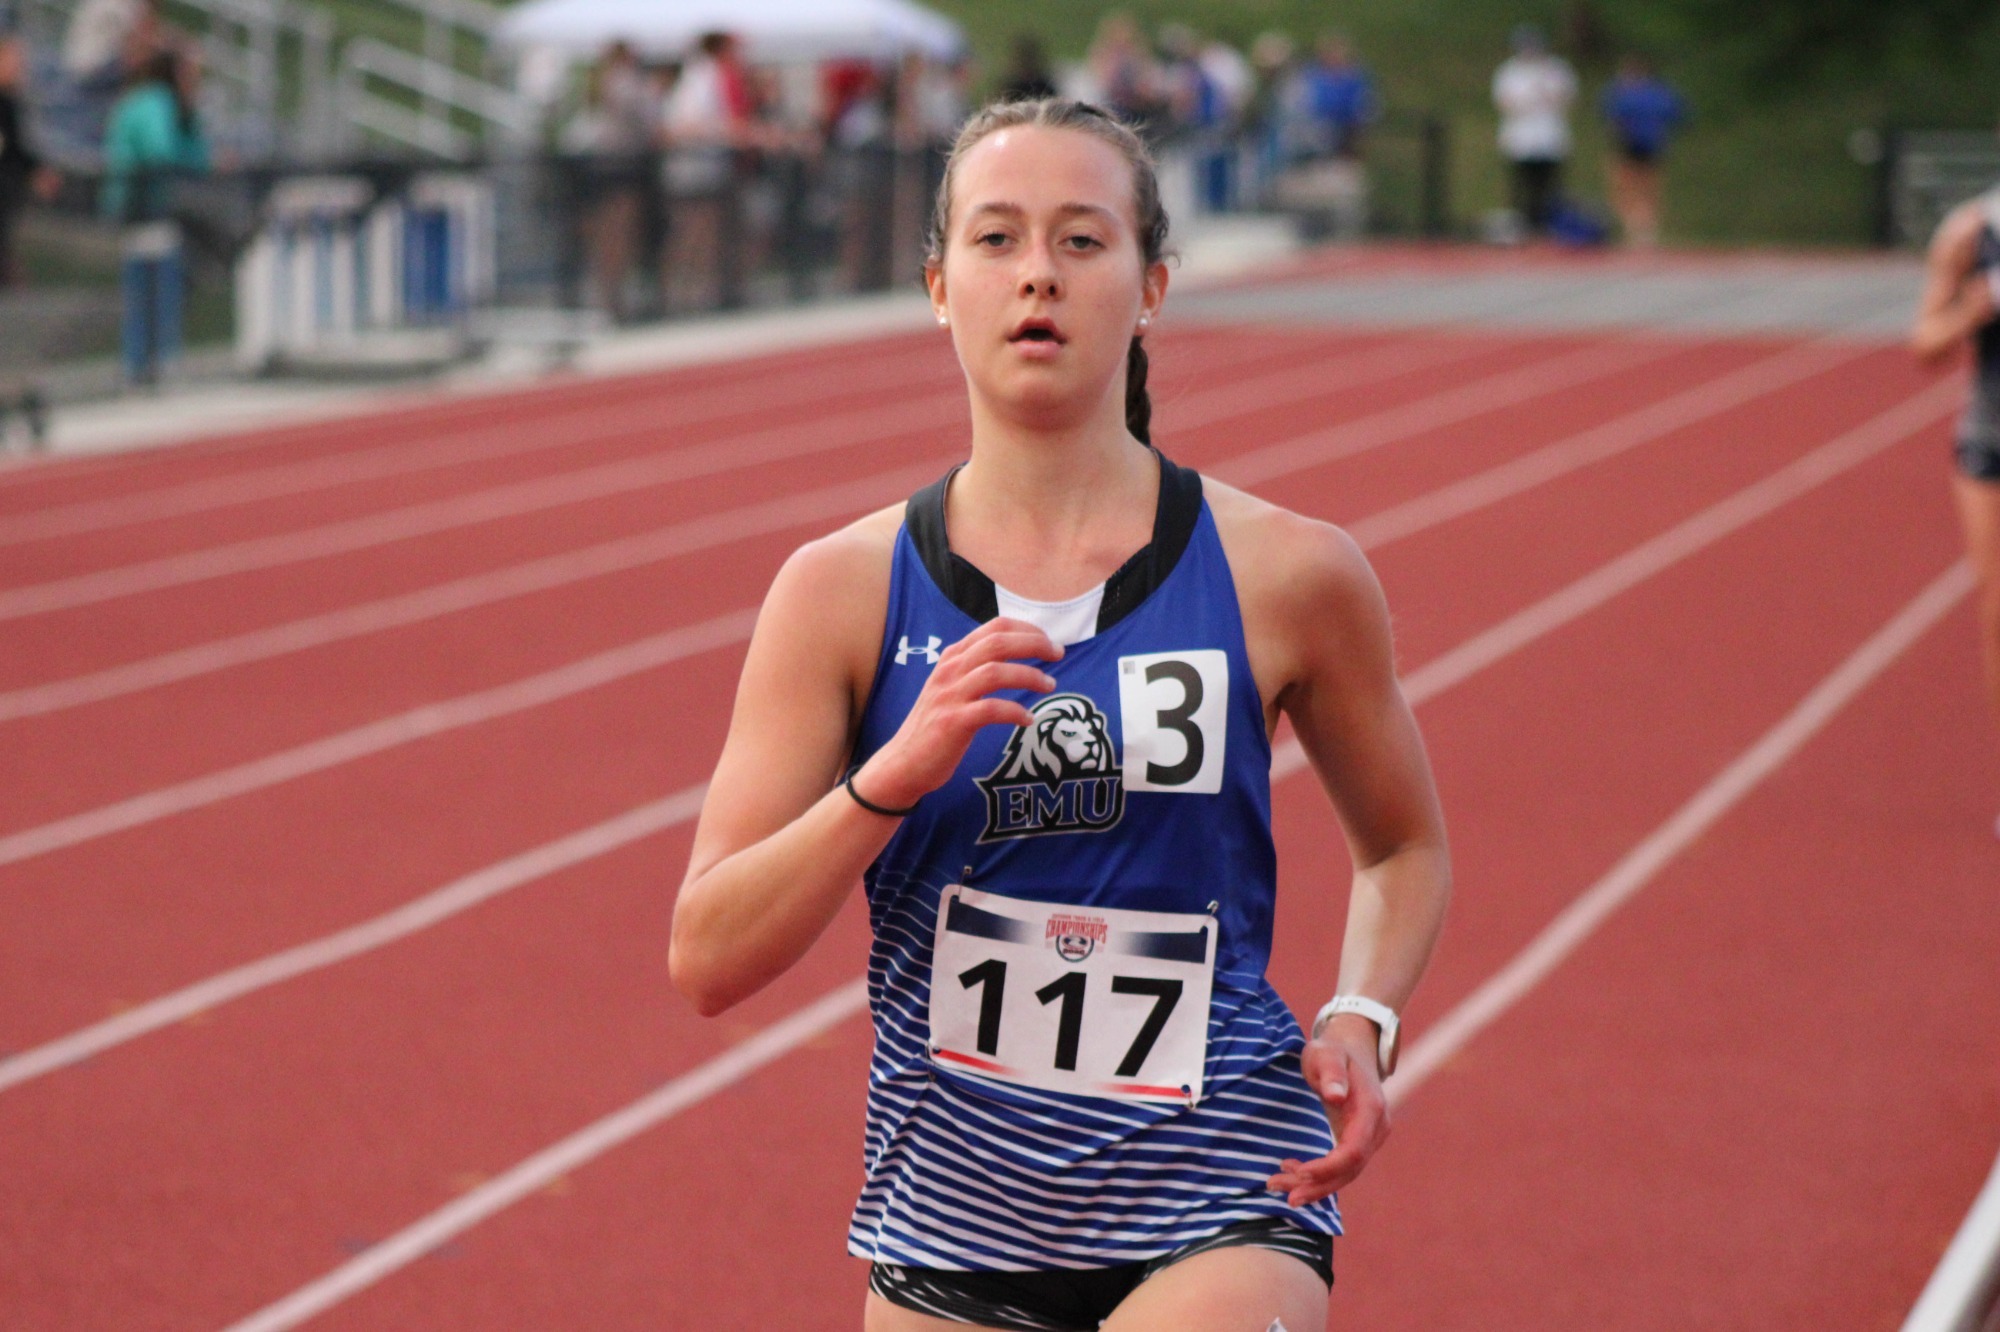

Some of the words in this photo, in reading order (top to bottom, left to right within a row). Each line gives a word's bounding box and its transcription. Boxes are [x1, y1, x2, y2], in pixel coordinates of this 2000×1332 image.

[1145, 660, 1204, 786] 3
[993, 776, 1120, 833] EMU
[1045, 919, 1108, 944] CHAMPIONSHIPS
[958, 958, 1183, 1077] 117
